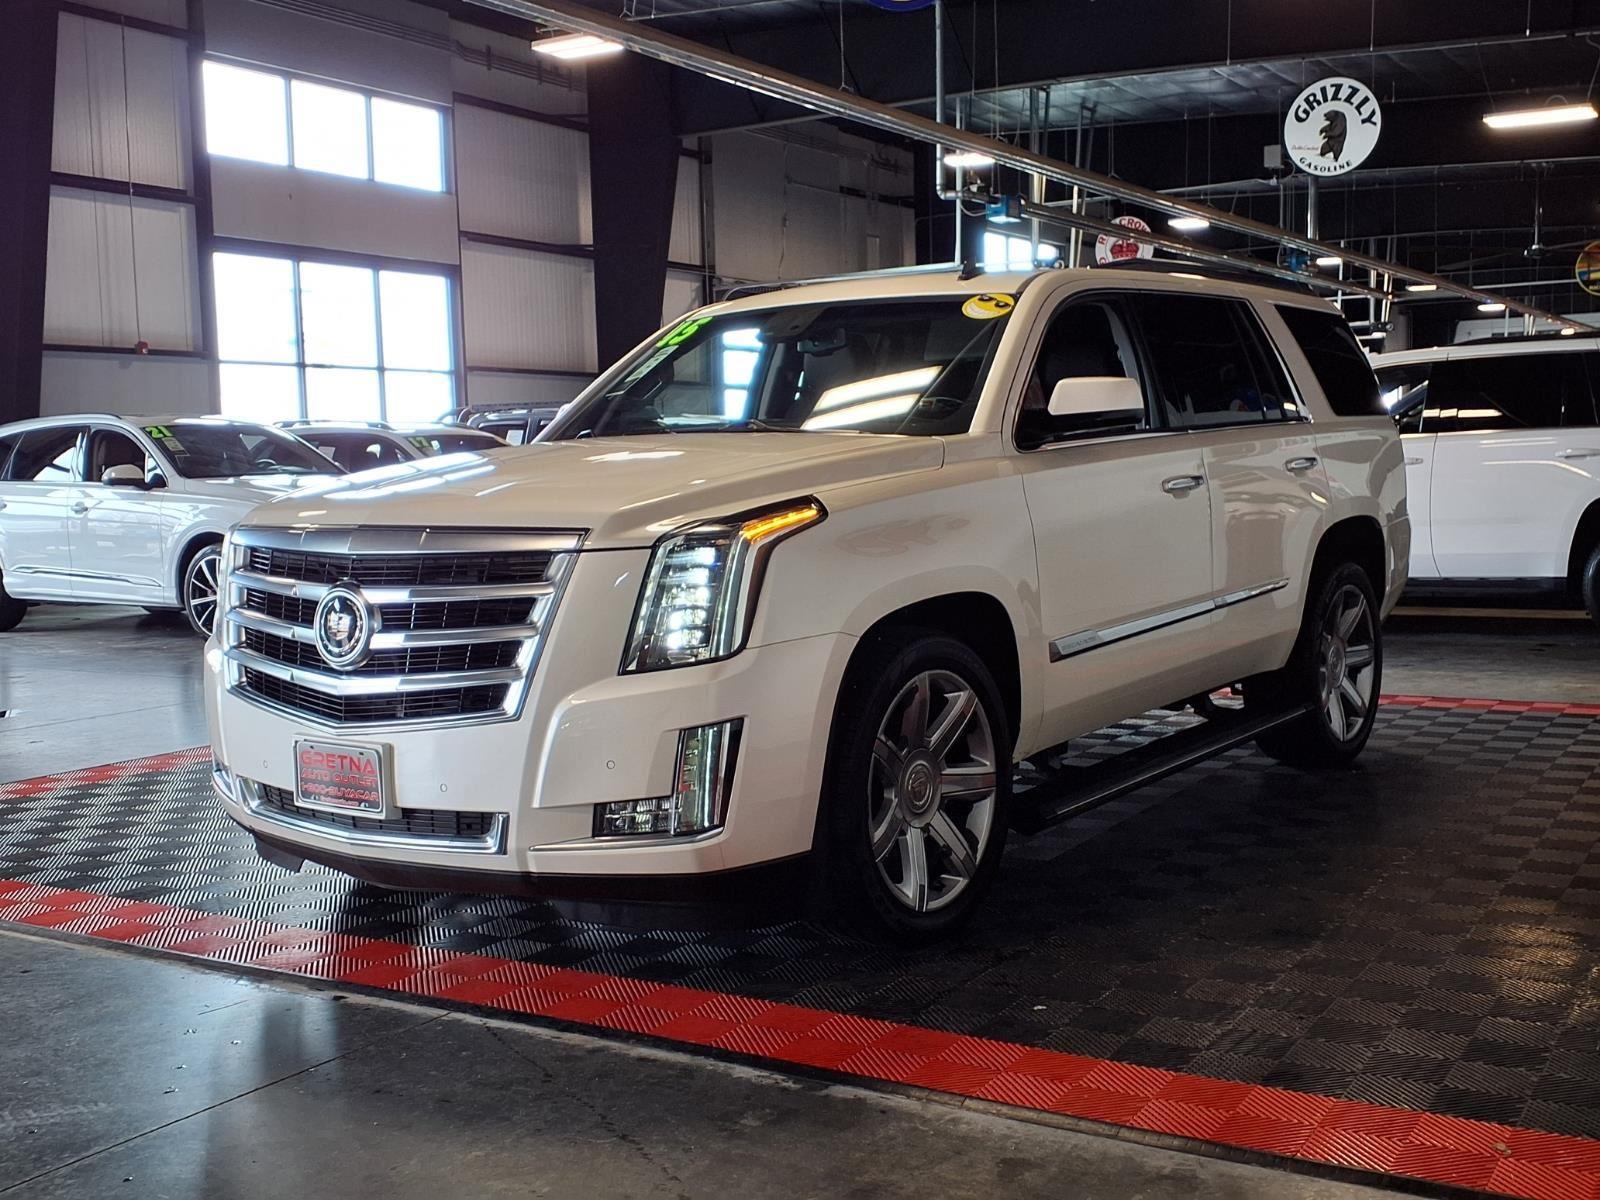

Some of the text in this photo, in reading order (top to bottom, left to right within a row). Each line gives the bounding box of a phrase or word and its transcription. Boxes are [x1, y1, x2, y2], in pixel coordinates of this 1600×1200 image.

[1294, 83, 1377, 126] GRIZZLY
[1300, 157, 1352, 172] GASOLINE
[145, 426, 173, 438] 21
[301, 750, 376, 775] GRETNA
[301, 768, 377, 788] AUTO OUTLET
